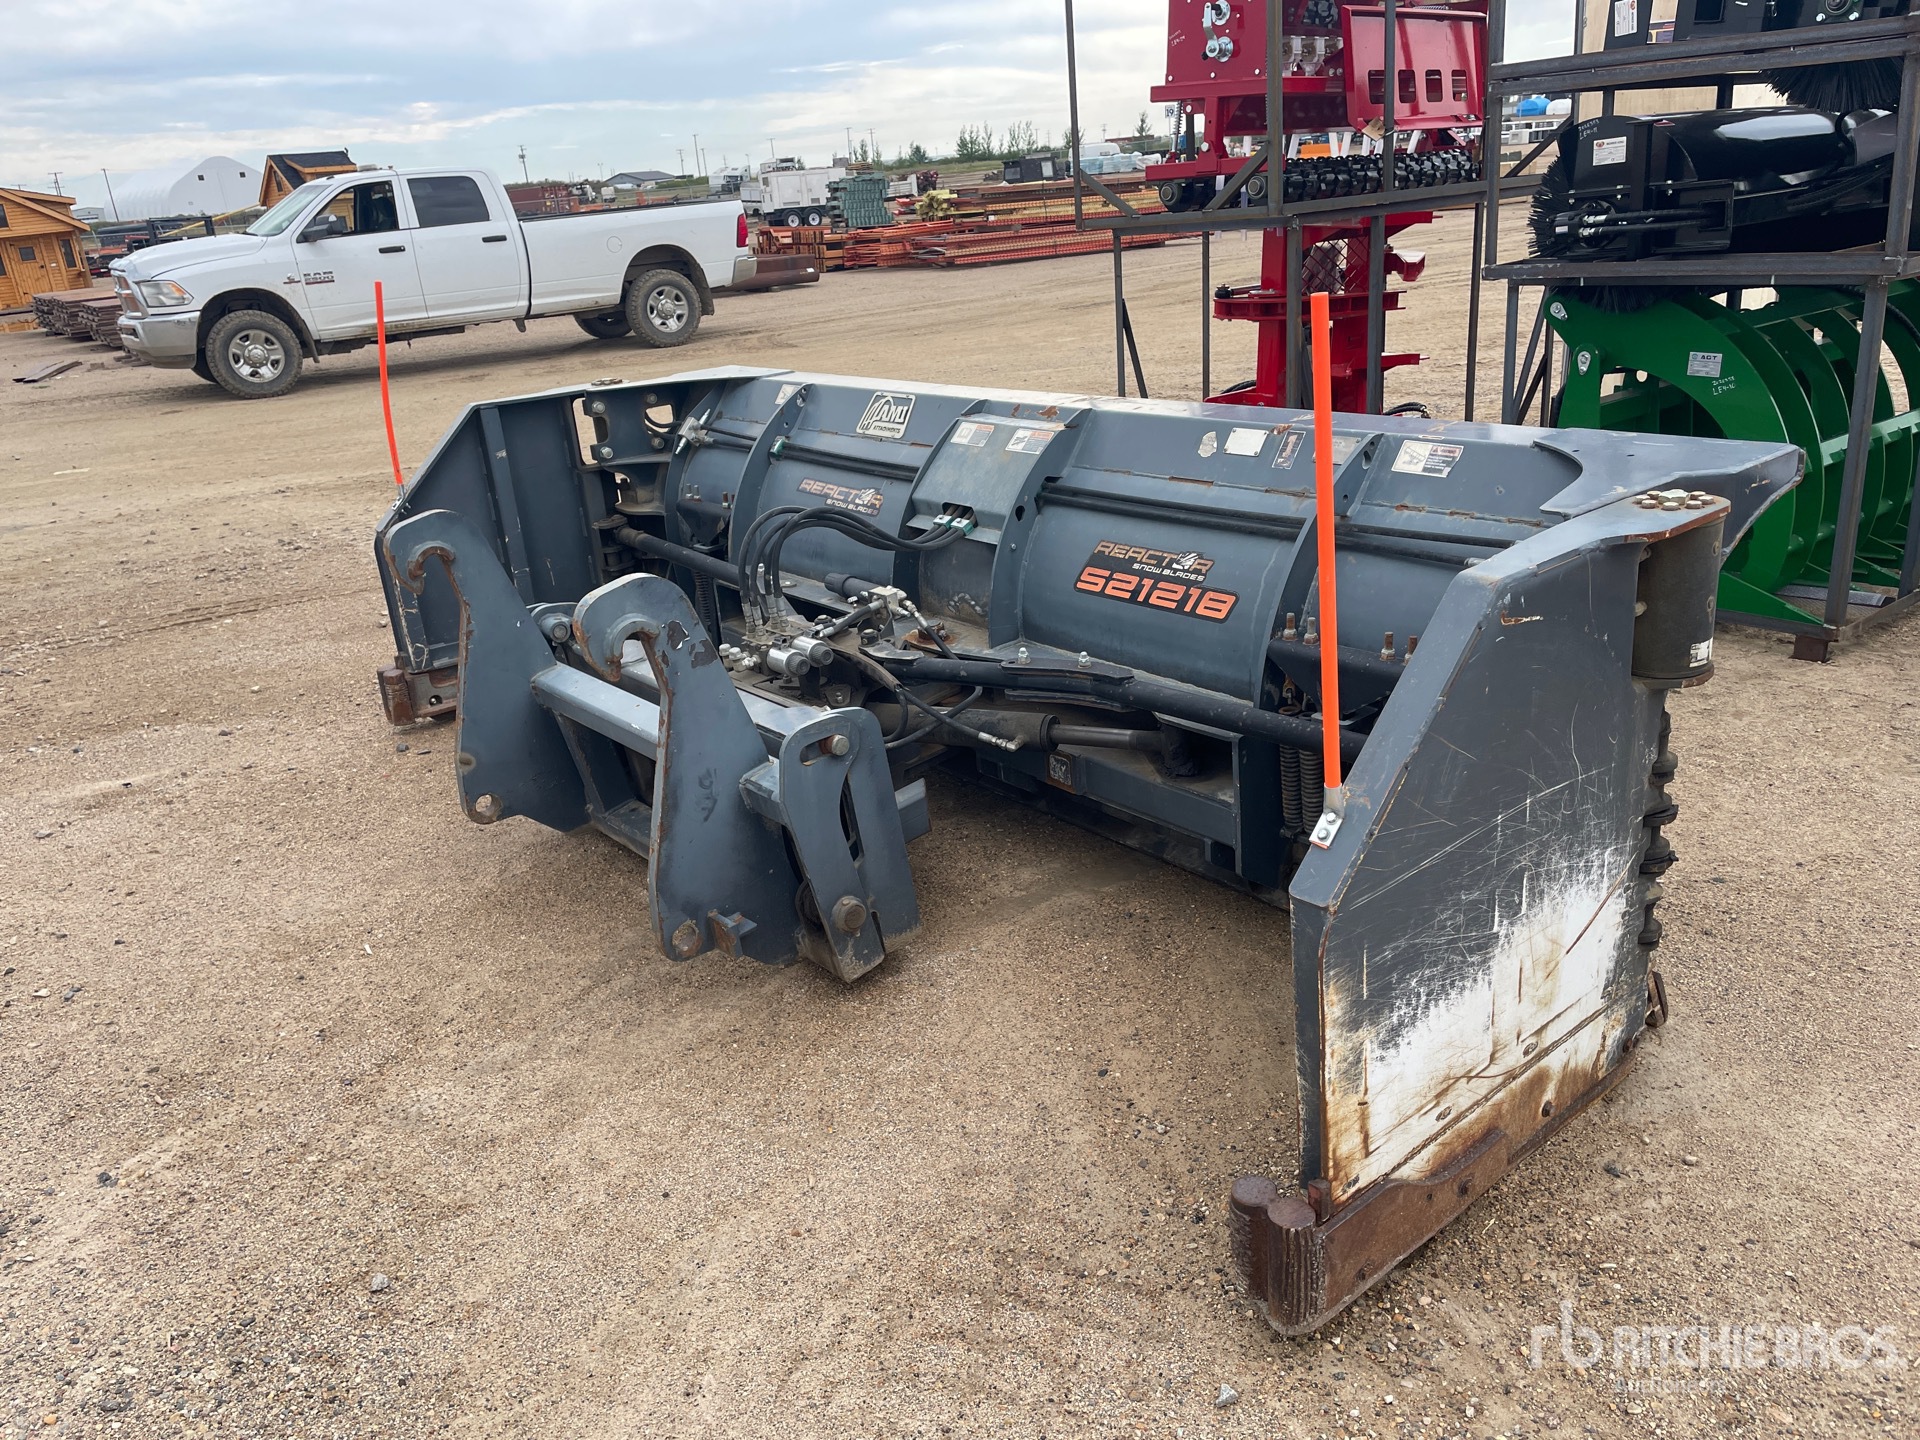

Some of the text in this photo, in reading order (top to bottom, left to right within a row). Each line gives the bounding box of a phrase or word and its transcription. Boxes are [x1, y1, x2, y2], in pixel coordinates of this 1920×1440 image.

[825, 498, 879, 516] SNOW BLADES
[1131, 562, 1206, 582] SNOW BLADES
